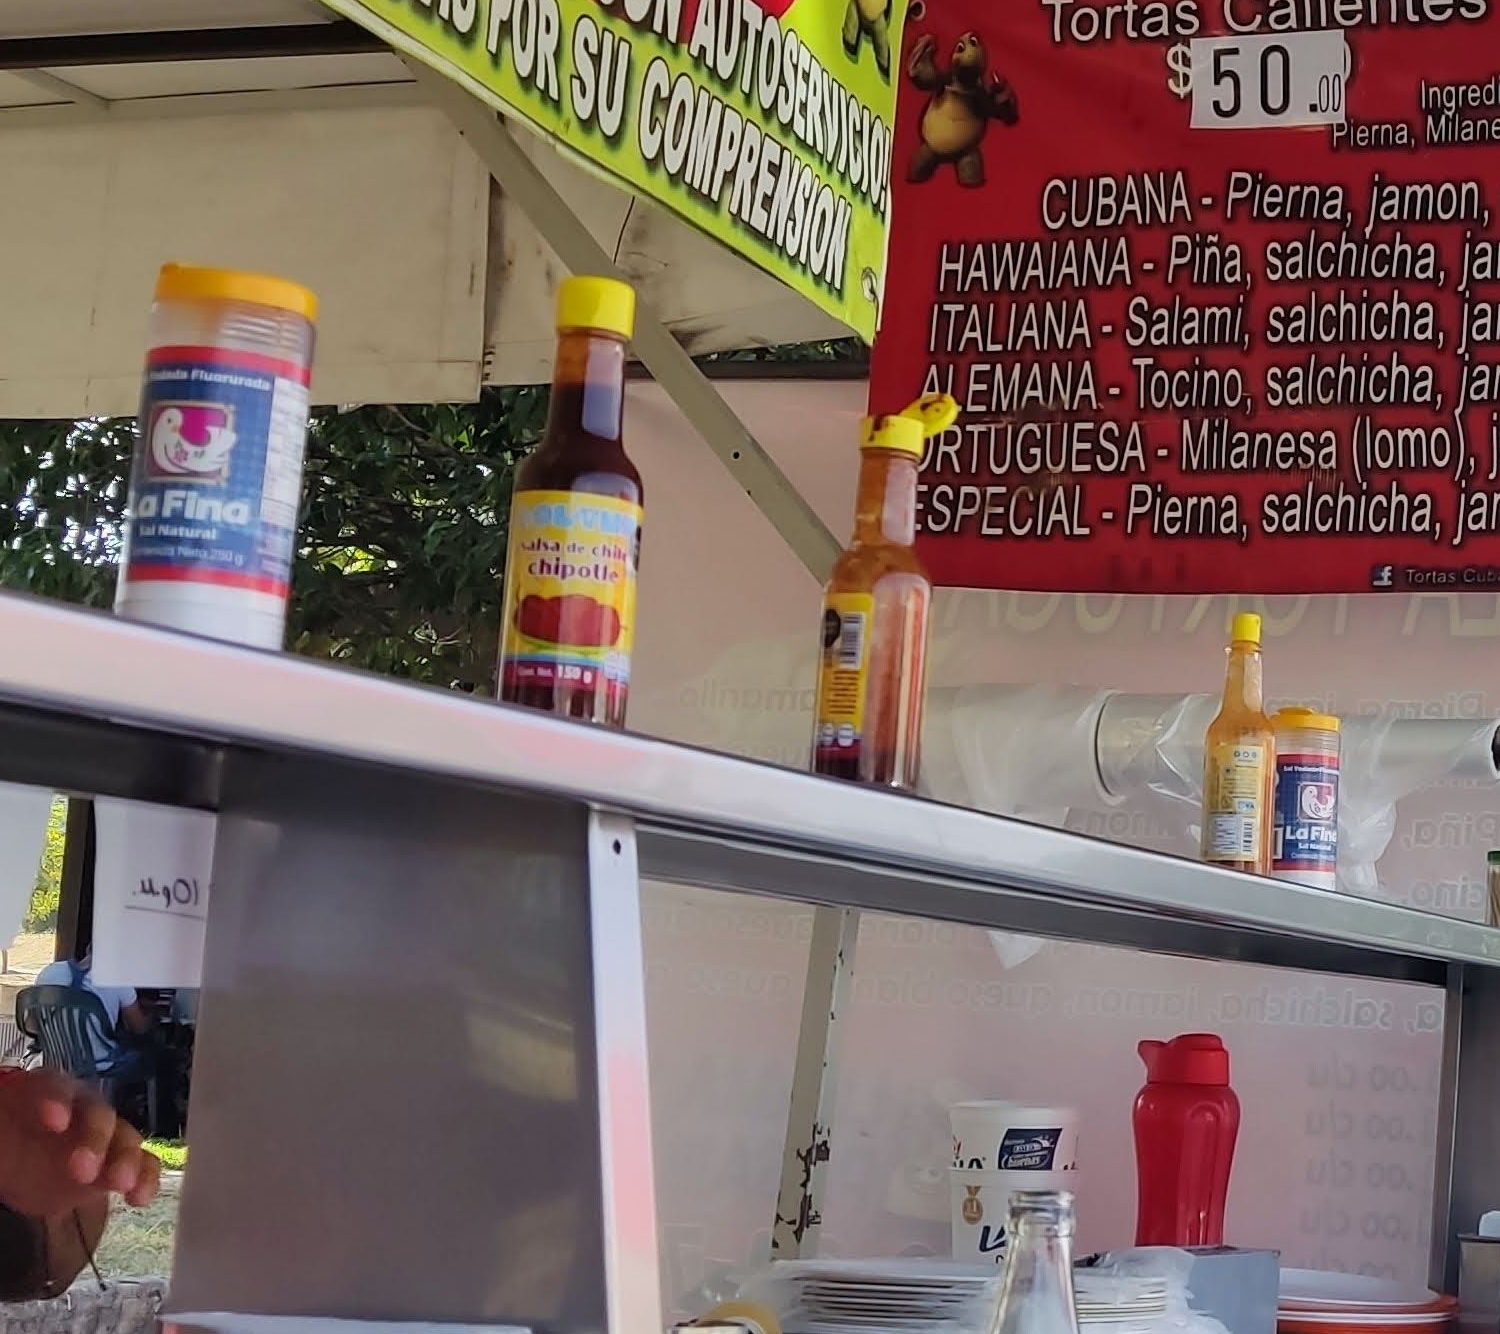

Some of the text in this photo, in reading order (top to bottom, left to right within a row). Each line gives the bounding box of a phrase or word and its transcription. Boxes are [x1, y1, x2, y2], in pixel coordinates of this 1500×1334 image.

[567, 15, 630, 137] SU
[637, 57, 851, 290] COMPRENSION
[1332, 121, 1415, 150] Pierna,
[1042, 172, 1192, 230] CUBANA
[1225, 171, 1353, 224] Pierna,
[1366, 176, 1489, 237] jamon,
[939, 239, 1132, 293] HAWAIANA
[1167, 234, 1252, 287] Piña,
[1266, 229, 1445, 288] salchicha,
[929, 300, 1092, 353] ITALIANA
[1125, 295, 1250, 350] Salami,
[1266, 291, 1444, 349] salchicha,
[1132, 357, 1252, 413] Tocino,
[1266, 354, 1444, 410] salchicha,
[1181, 419, 1337, 471] Milanesa
[157, 524, 218, 540] Natural
[162, 489, 250, 525] Fina
[1126, 482, 1248, 542] Pierna,
[1262, 482, 1441, 540] salchicha,
[528, 557, 618, 581] chipotle
[1406, 569, 1456, 583] Tortas
[1285, 825, 1309, 840] La
